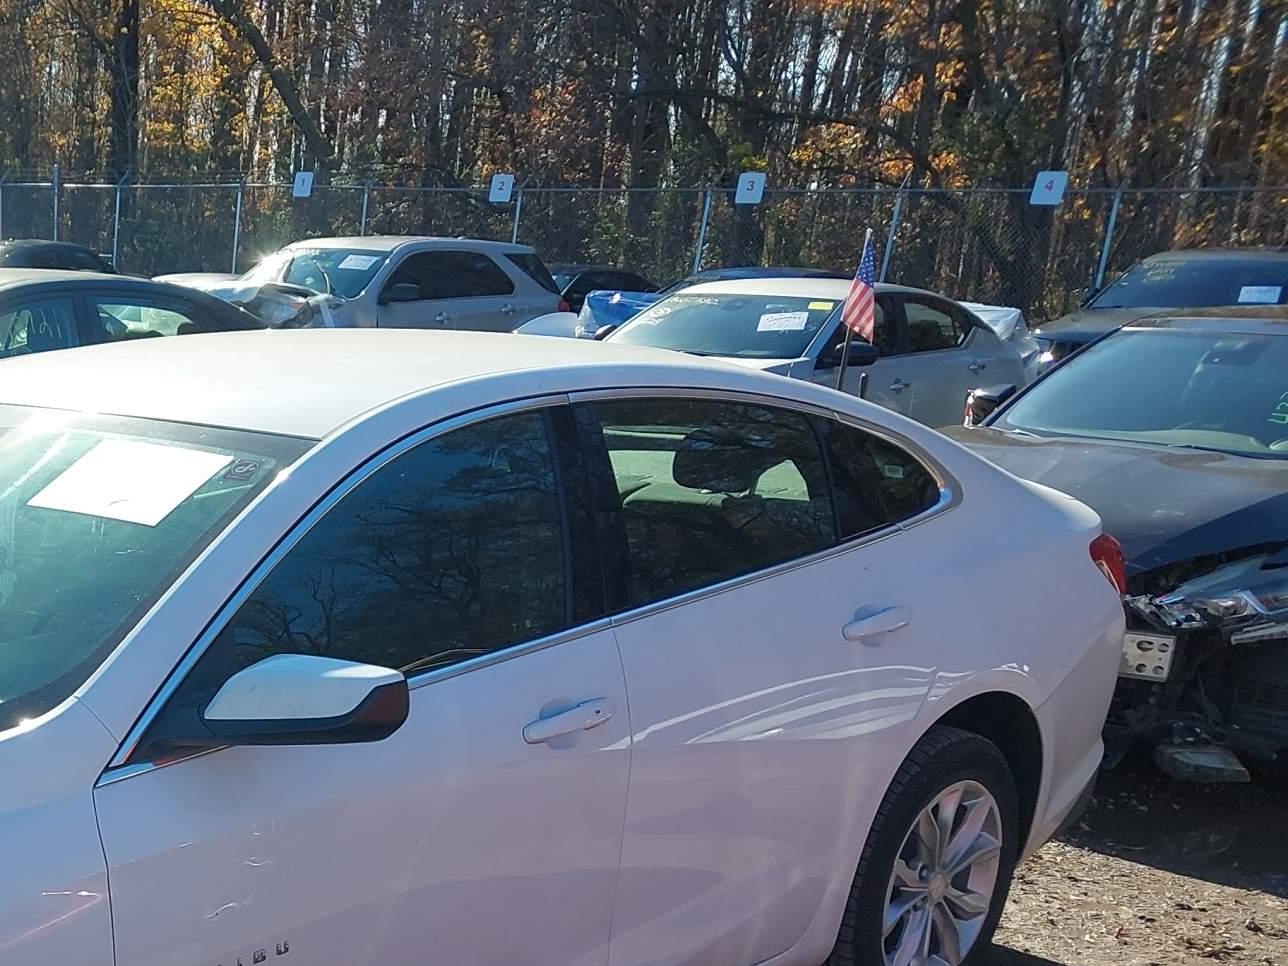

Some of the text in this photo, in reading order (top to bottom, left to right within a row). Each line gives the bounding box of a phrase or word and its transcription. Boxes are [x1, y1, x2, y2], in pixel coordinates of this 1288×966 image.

[497, 180, 506, 191] 2
[746, 180, 755, 191] 3
[1044, 179, 1054, 192] 4
